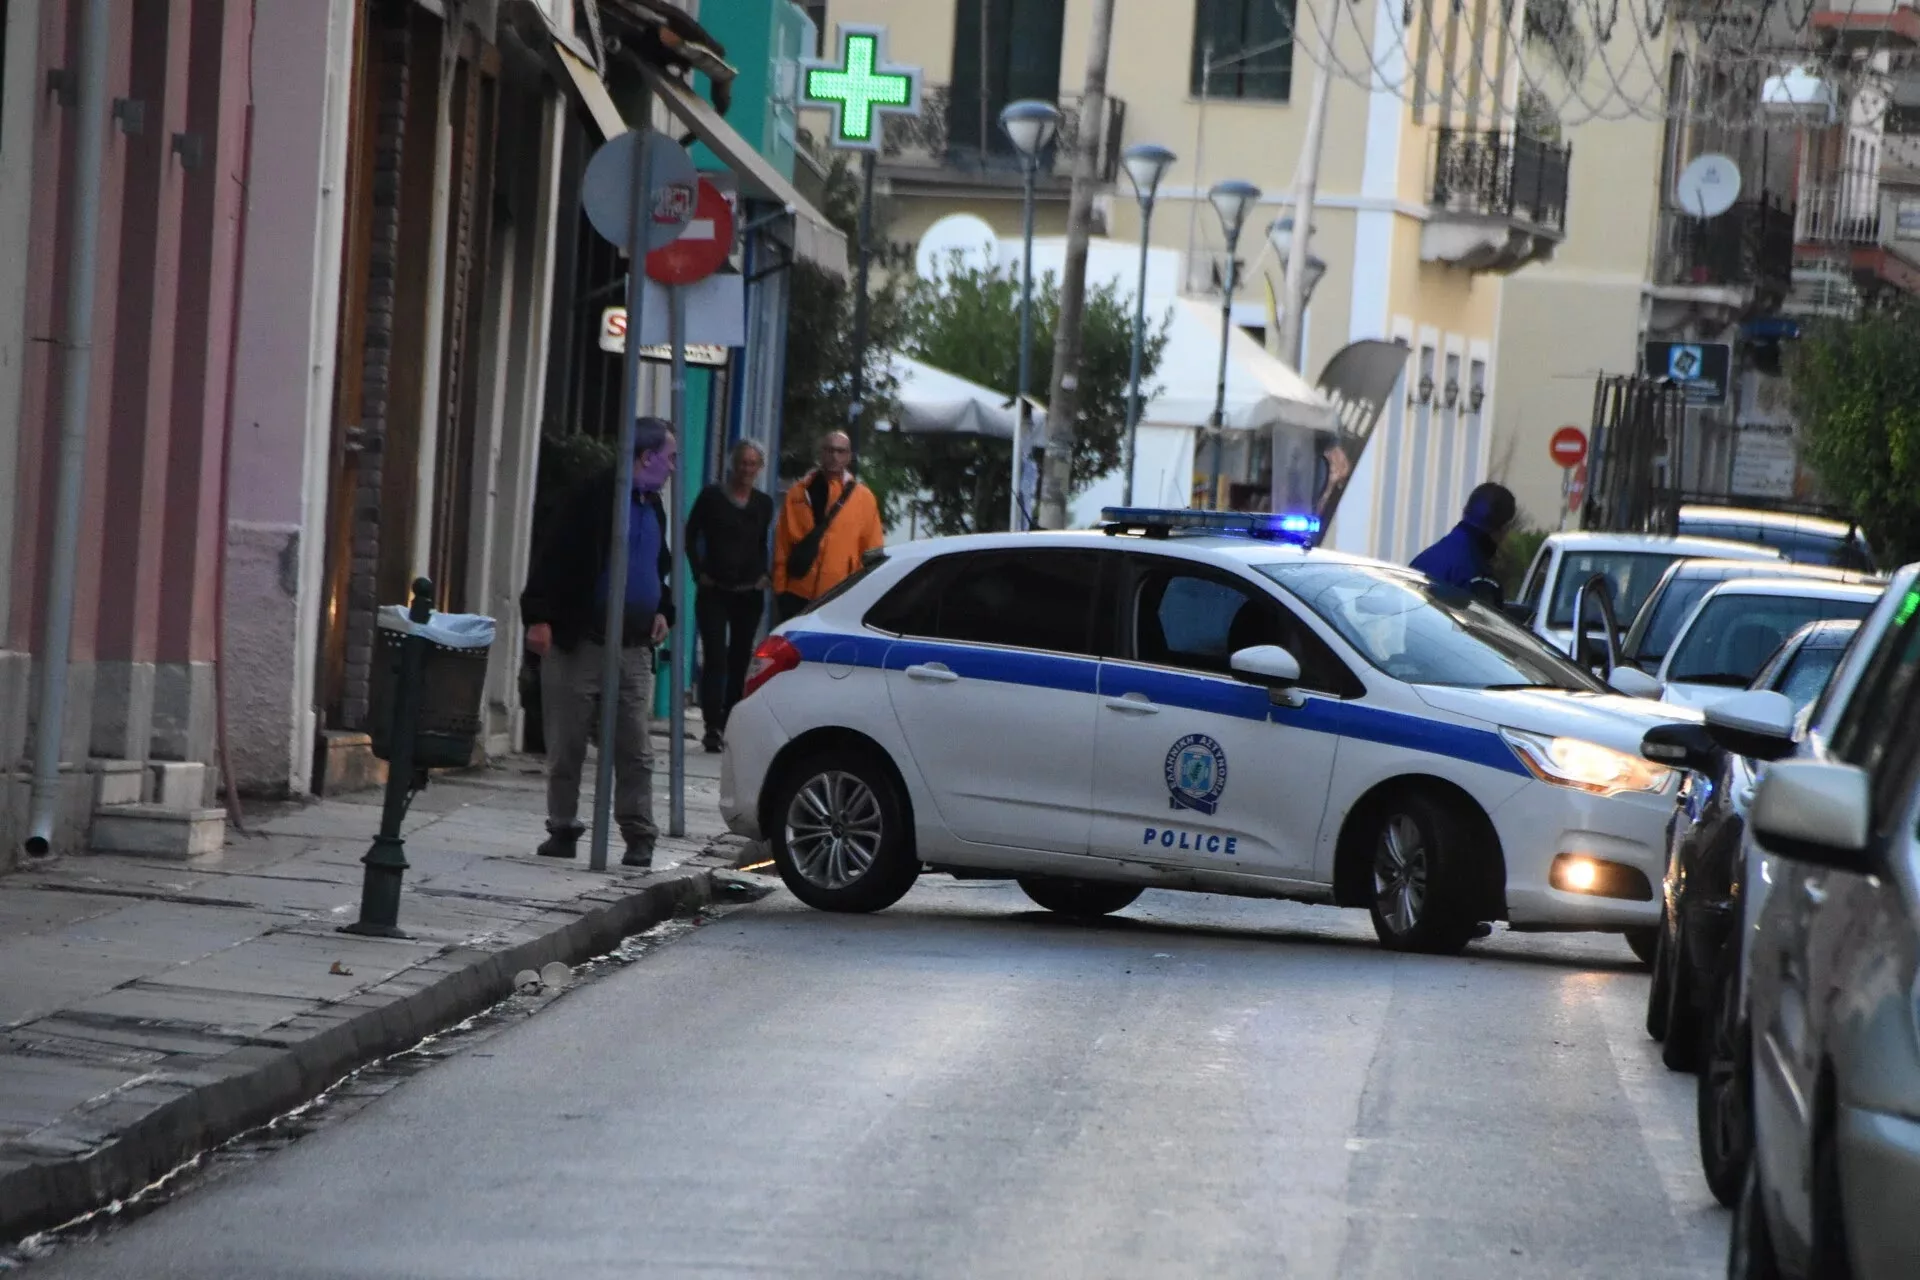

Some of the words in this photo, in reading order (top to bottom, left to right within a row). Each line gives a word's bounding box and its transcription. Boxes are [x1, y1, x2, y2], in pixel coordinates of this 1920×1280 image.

[1166, 736, 1194, 789] ΕΛΛΗΝΙΚΗ
[1199, 736, 1226, 796] ΑΣΤΥΝΟΜΙΑ
[1143, 828, 1238, 855] POLICE
